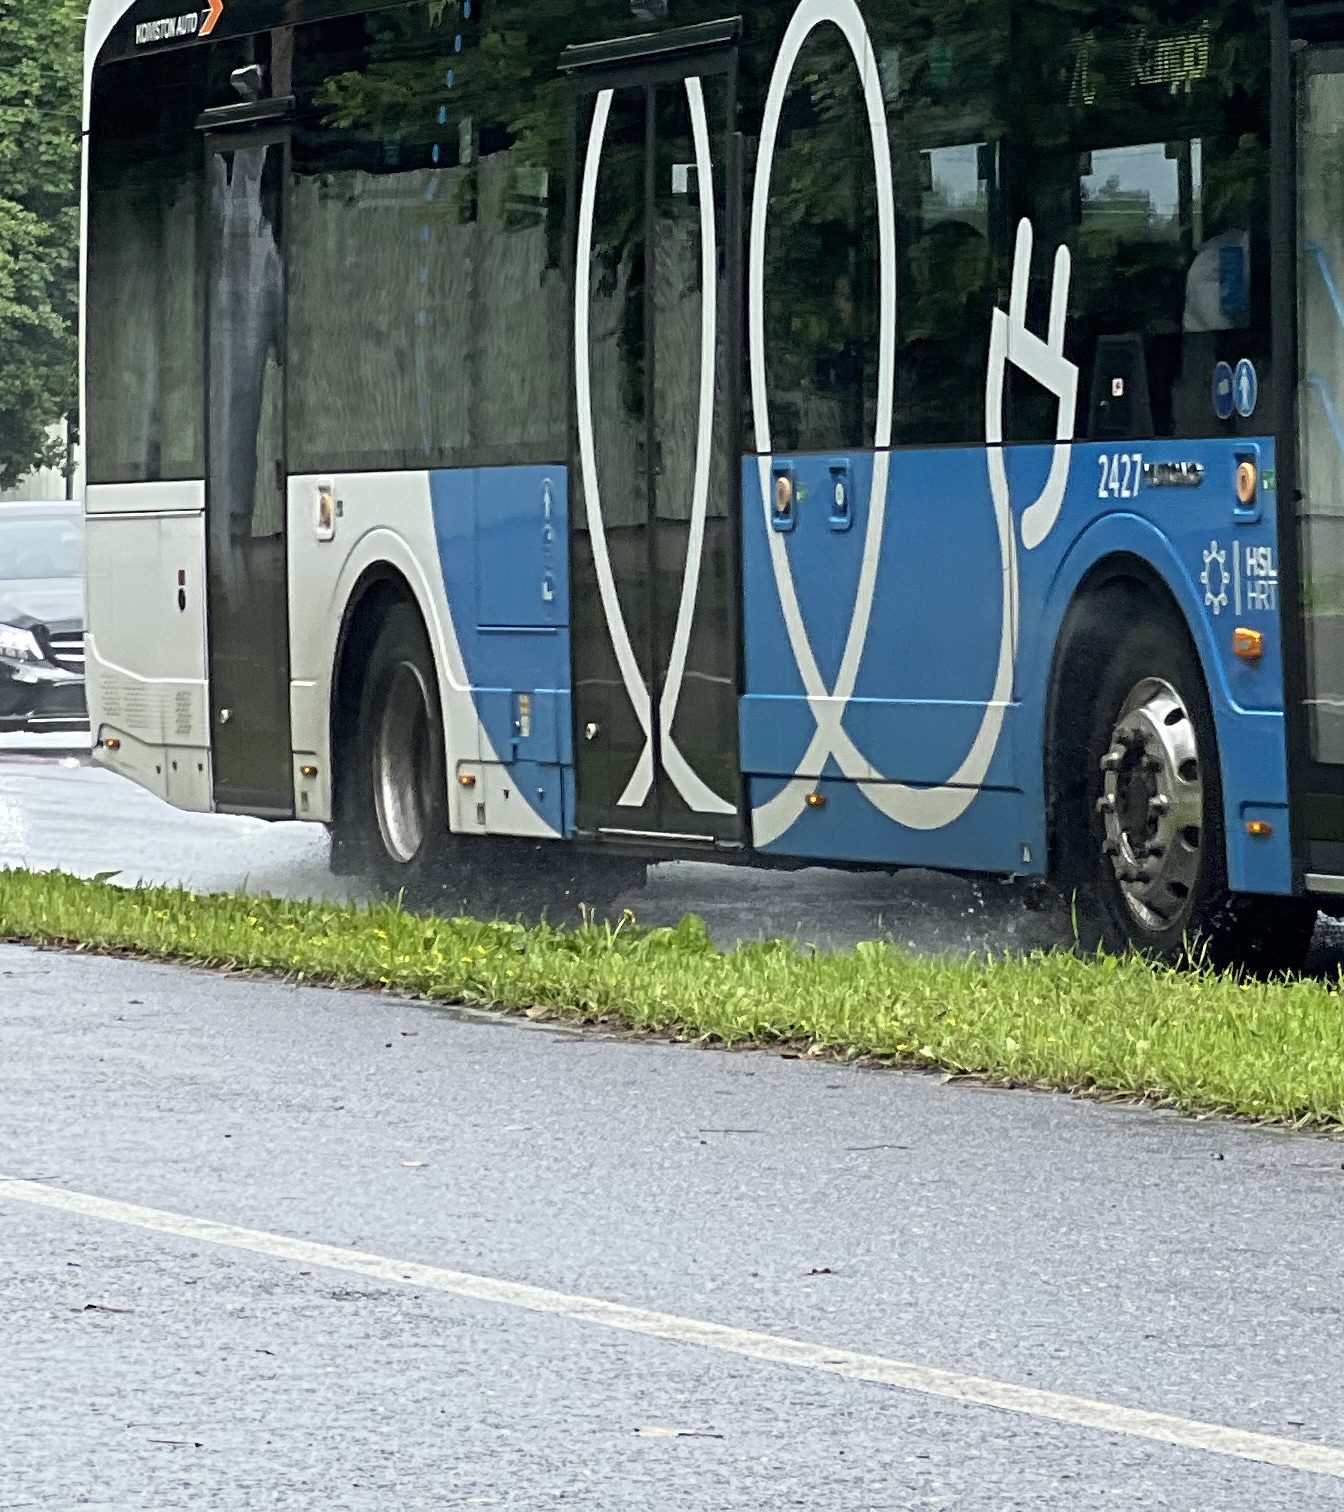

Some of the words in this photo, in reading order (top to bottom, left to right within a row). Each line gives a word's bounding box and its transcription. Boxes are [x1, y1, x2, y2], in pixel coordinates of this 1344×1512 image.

[1098, 452, 1143, 499] 2427
[1245, 546, 1278, 577] HSL
[1247, 580, 1279, 611] HRT
